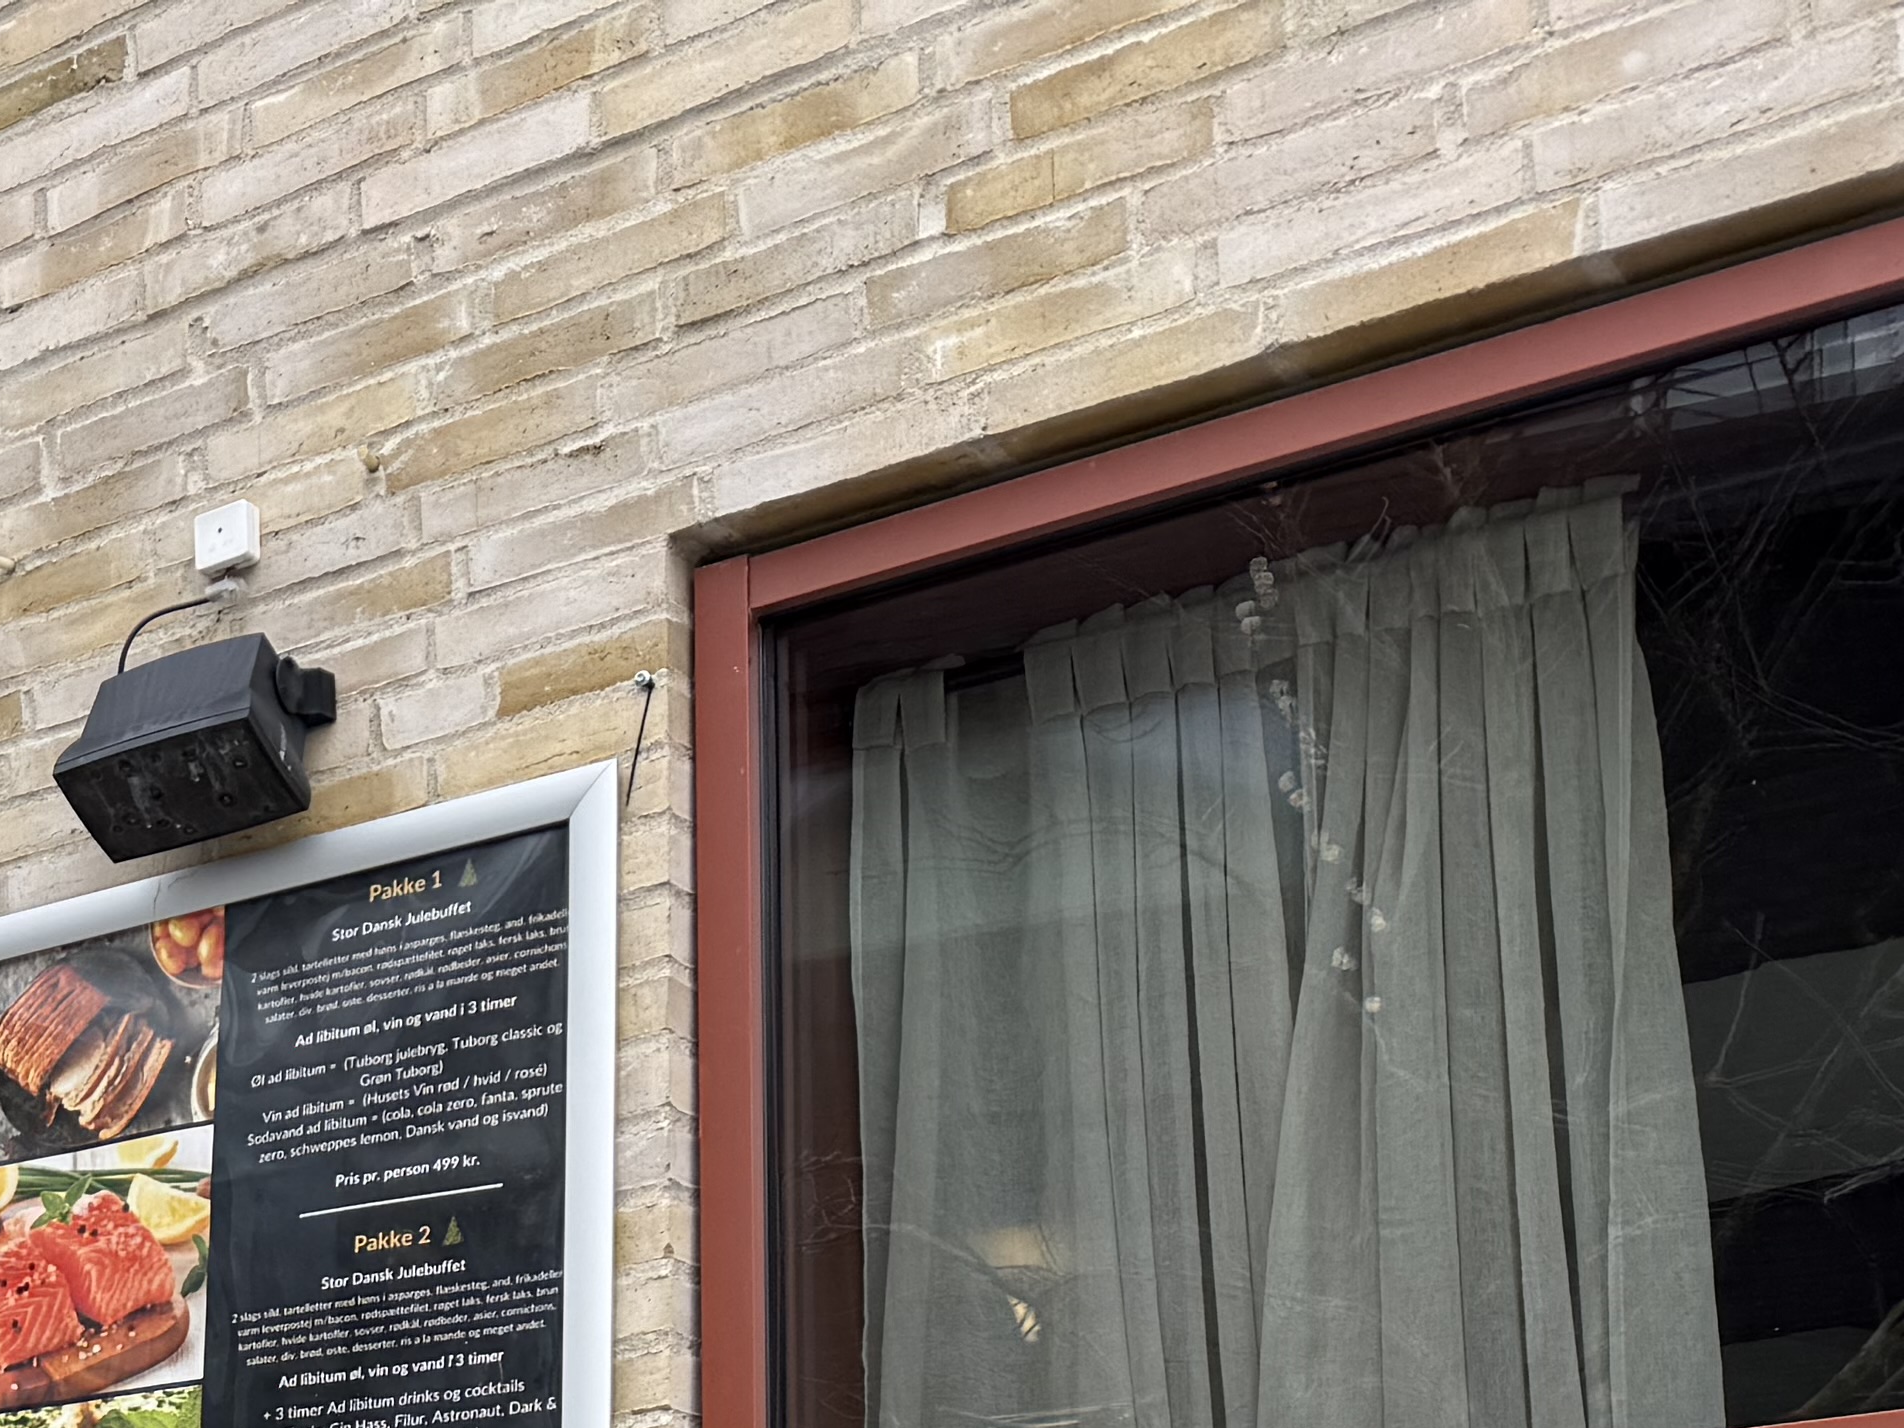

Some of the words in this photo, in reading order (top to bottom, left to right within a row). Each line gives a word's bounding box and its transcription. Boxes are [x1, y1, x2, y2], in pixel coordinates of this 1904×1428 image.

[369, 877, 426, 903] Pakke
[432, 870, 442, 889] 1
[332, 927, 359, 942] Stor
[362, 915, 402, 936] Dansk
[404, 900, 472, 926] Julebuffet
[294, 1032, 314, 1048] Ad
[316, 1025, 361, 1044] libitum
[383, 1016, 403, 1031] vin
[405, 1013, 422, 1027] og
[424, 1003, 457, 1022] vand
[460, 1002, 465, 1016] i
[468, 1000, 477, 1014] 3
[480, 996, 518, 1012] timer
[290, 1137, 358, 1158] schweppes
[405, 1120, 445, 1139] Dansk
[447, 1114, 480, 1130] vand
[482, 1113, 499, 1127] og
[502, 1102, 549, 1122] isvand)
[335, 1172, 360, 1188] Pris
[362, 1171, 381, 1186] pr.
[383, 1163, 430, 1183] person
[432, 1155, 460, 1172] 499
[462, 1154, 481, 1168] kr.
[354, 1230, 413, 1254] Pakke
[418, 1225, 431, 1245] 2
[321, 1276, 349, 1290] Stor
[352, 1267, 394, 1286] Dansk
[396, 1259, 466, 1280] Julebuffet
[509, 1398, 542, 1415] Dark
